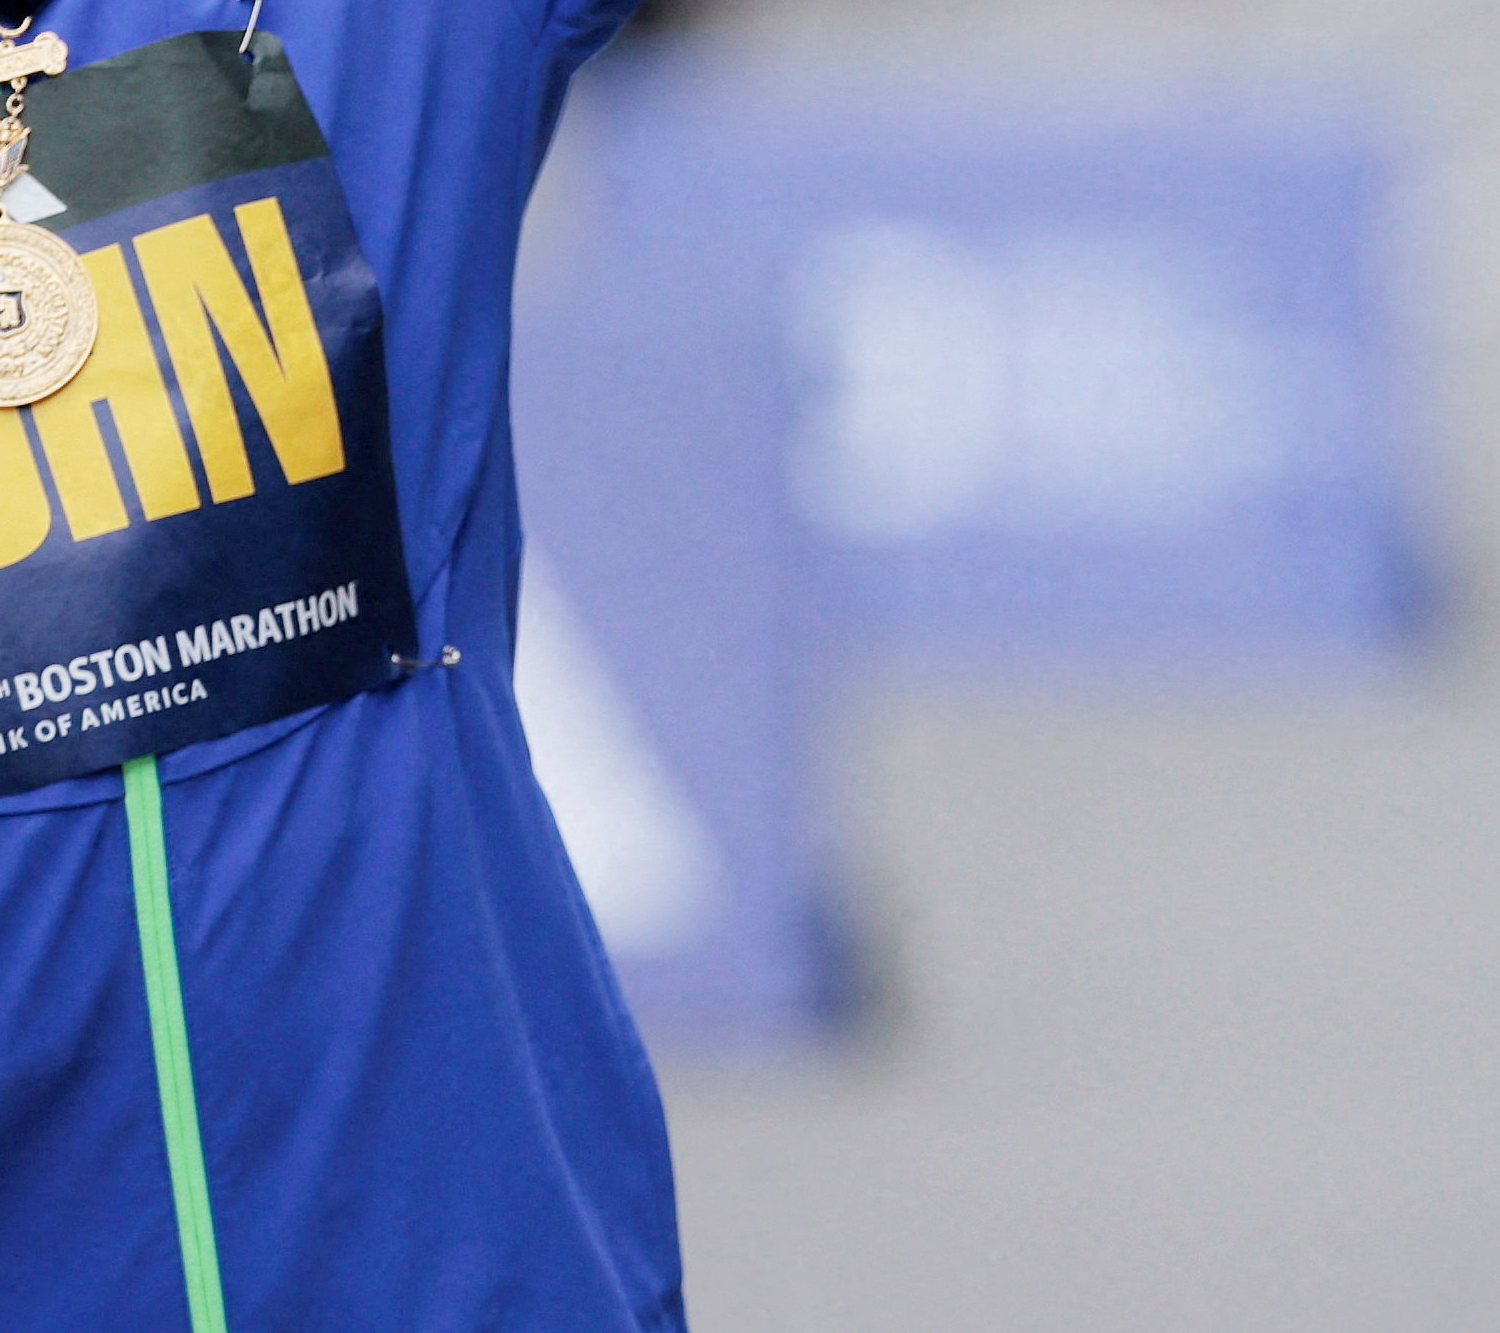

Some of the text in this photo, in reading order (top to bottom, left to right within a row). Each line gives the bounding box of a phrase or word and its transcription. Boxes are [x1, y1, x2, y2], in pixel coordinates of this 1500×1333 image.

[13, 634, 172, 712] BOSTON
[175, 579, 359, 668] MARATHON
[34, 713, 73, 744] OF
[81, 678, 209, 732] AMERICA
